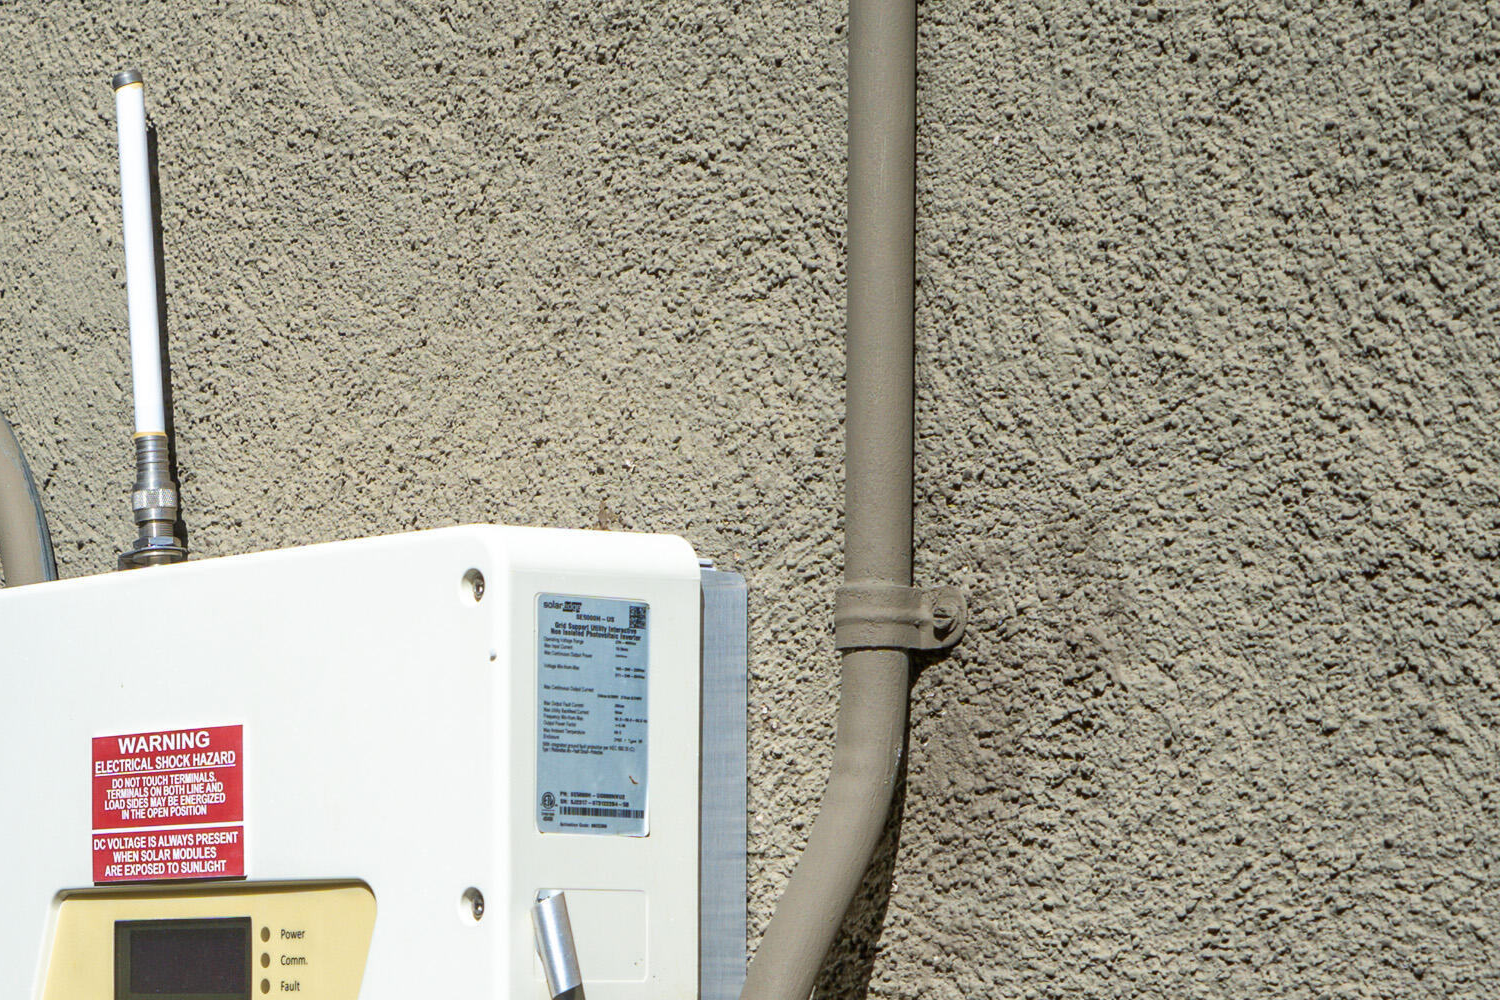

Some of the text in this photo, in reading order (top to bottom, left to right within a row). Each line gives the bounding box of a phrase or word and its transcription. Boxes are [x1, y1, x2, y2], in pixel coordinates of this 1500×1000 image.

[118, 731, 210, 754] WARNING
[95, 751, 236, 774] ELECTRICAL SHOCK HAZARD
[112, 772, 216, 789] DO NOT TOUCH TERMINALS.
[106, 782, 223, 799] TERMINALS ON BOTH LINE AND
[104, 793, 225, 810] LOAD SIDES MAY BE ENERGIZED
[122, 805, 207, 819] IN THE OPEN POSITION
[94, 832, 238, 850] DC VOLTAGE IS ALWAYS PRESENT
[113, 847, 217, 863] WHEN SOLAR MODULES
[104, 860, 227, 877] ARE EXPOSED TO SUNLIGHT
[280, 929, 305, 940] Power
[280, 955, 308, 966] Comm.
[280, 981, 301, 991] Fault
